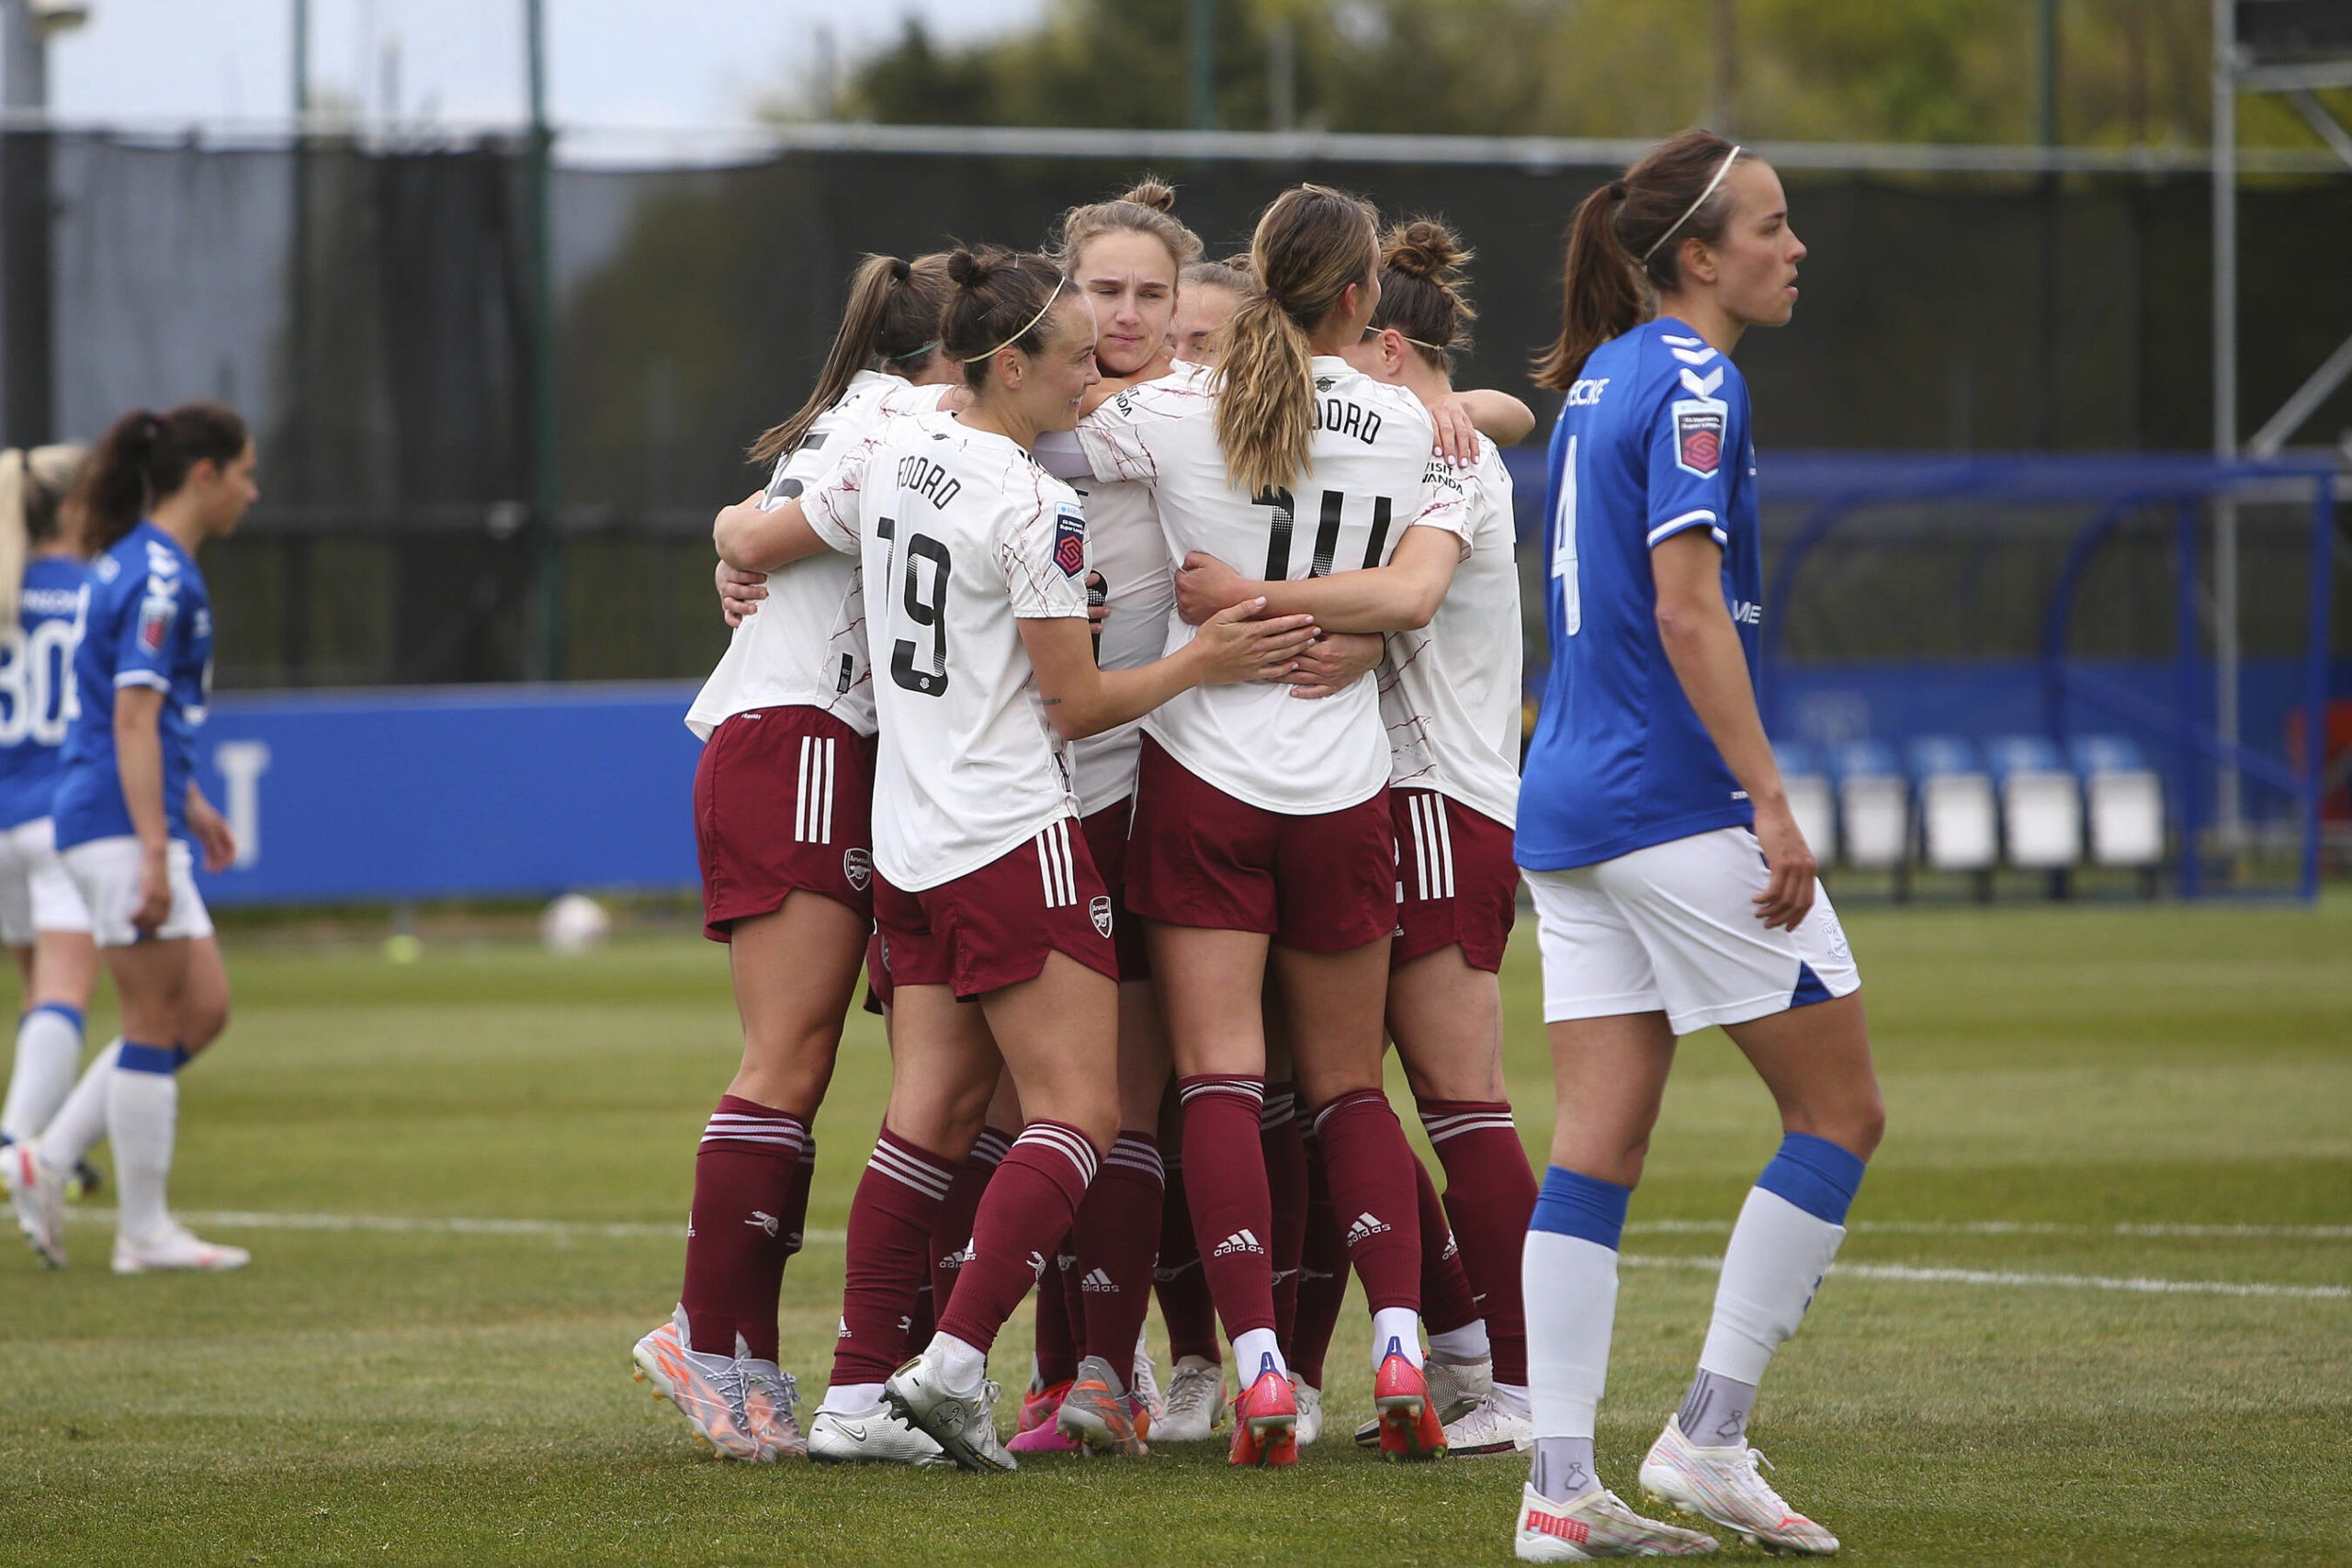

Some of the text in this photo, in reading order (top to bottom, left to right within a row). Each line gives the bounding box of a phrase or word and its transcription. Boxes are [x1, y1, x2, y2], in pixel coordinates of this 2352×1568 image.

[1564, 378, 1611, 410] ECKE
[1309, 397, 1382, 445] OORD
[897, 456, 961, 510] FOORD
[1421, 473, 1464, 495] ANDA
[1551, 434, 1581, 636] 4
[877, 517, 952, 697] 19
[1214, 1243, 1265, 1258] adidas
[1347, 1224, 1392, 1247] adidas
[1526, 1510, 1589, 1545] PUMA
